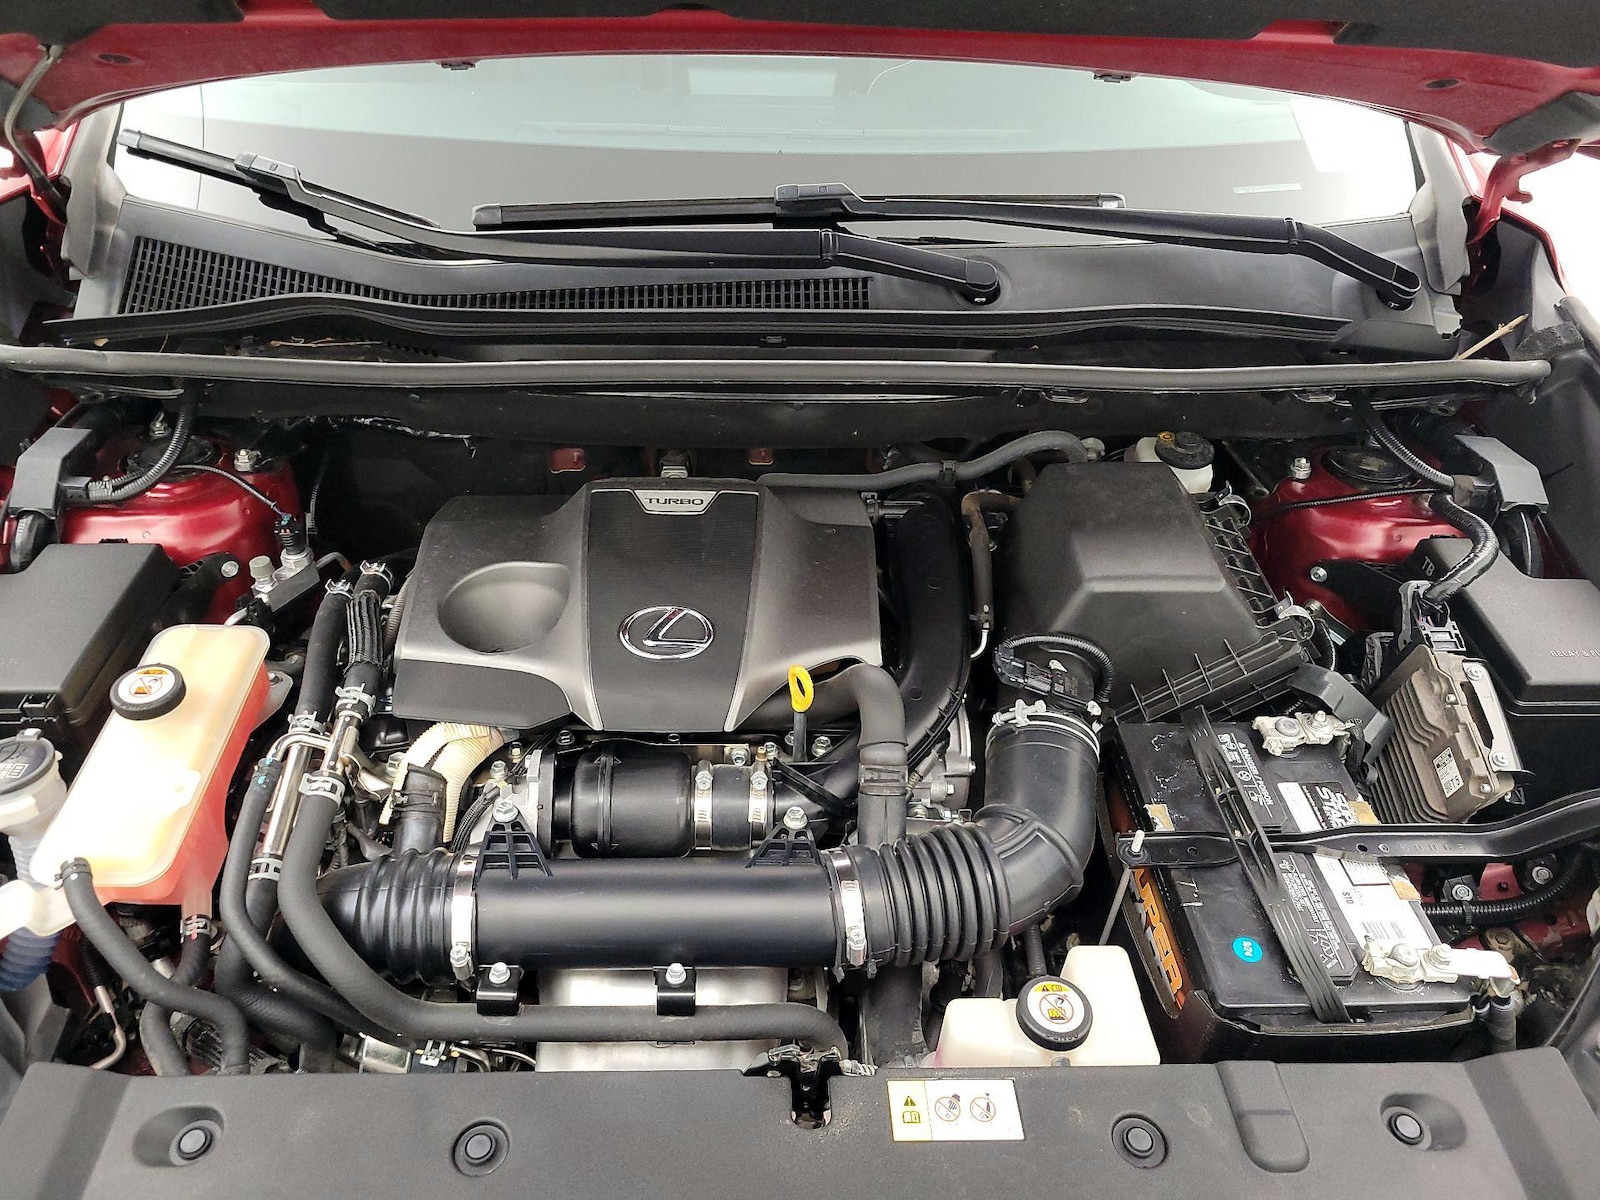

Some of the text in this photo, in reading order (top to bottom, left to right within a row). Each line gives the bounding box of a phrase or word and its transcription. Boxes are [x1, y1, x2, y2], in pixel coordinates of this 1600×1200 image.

[645, 497, 704, 506] TURBO
[1421, 556, 1436, 577] TB
[1242, 748, 1258, 775] DANGER
